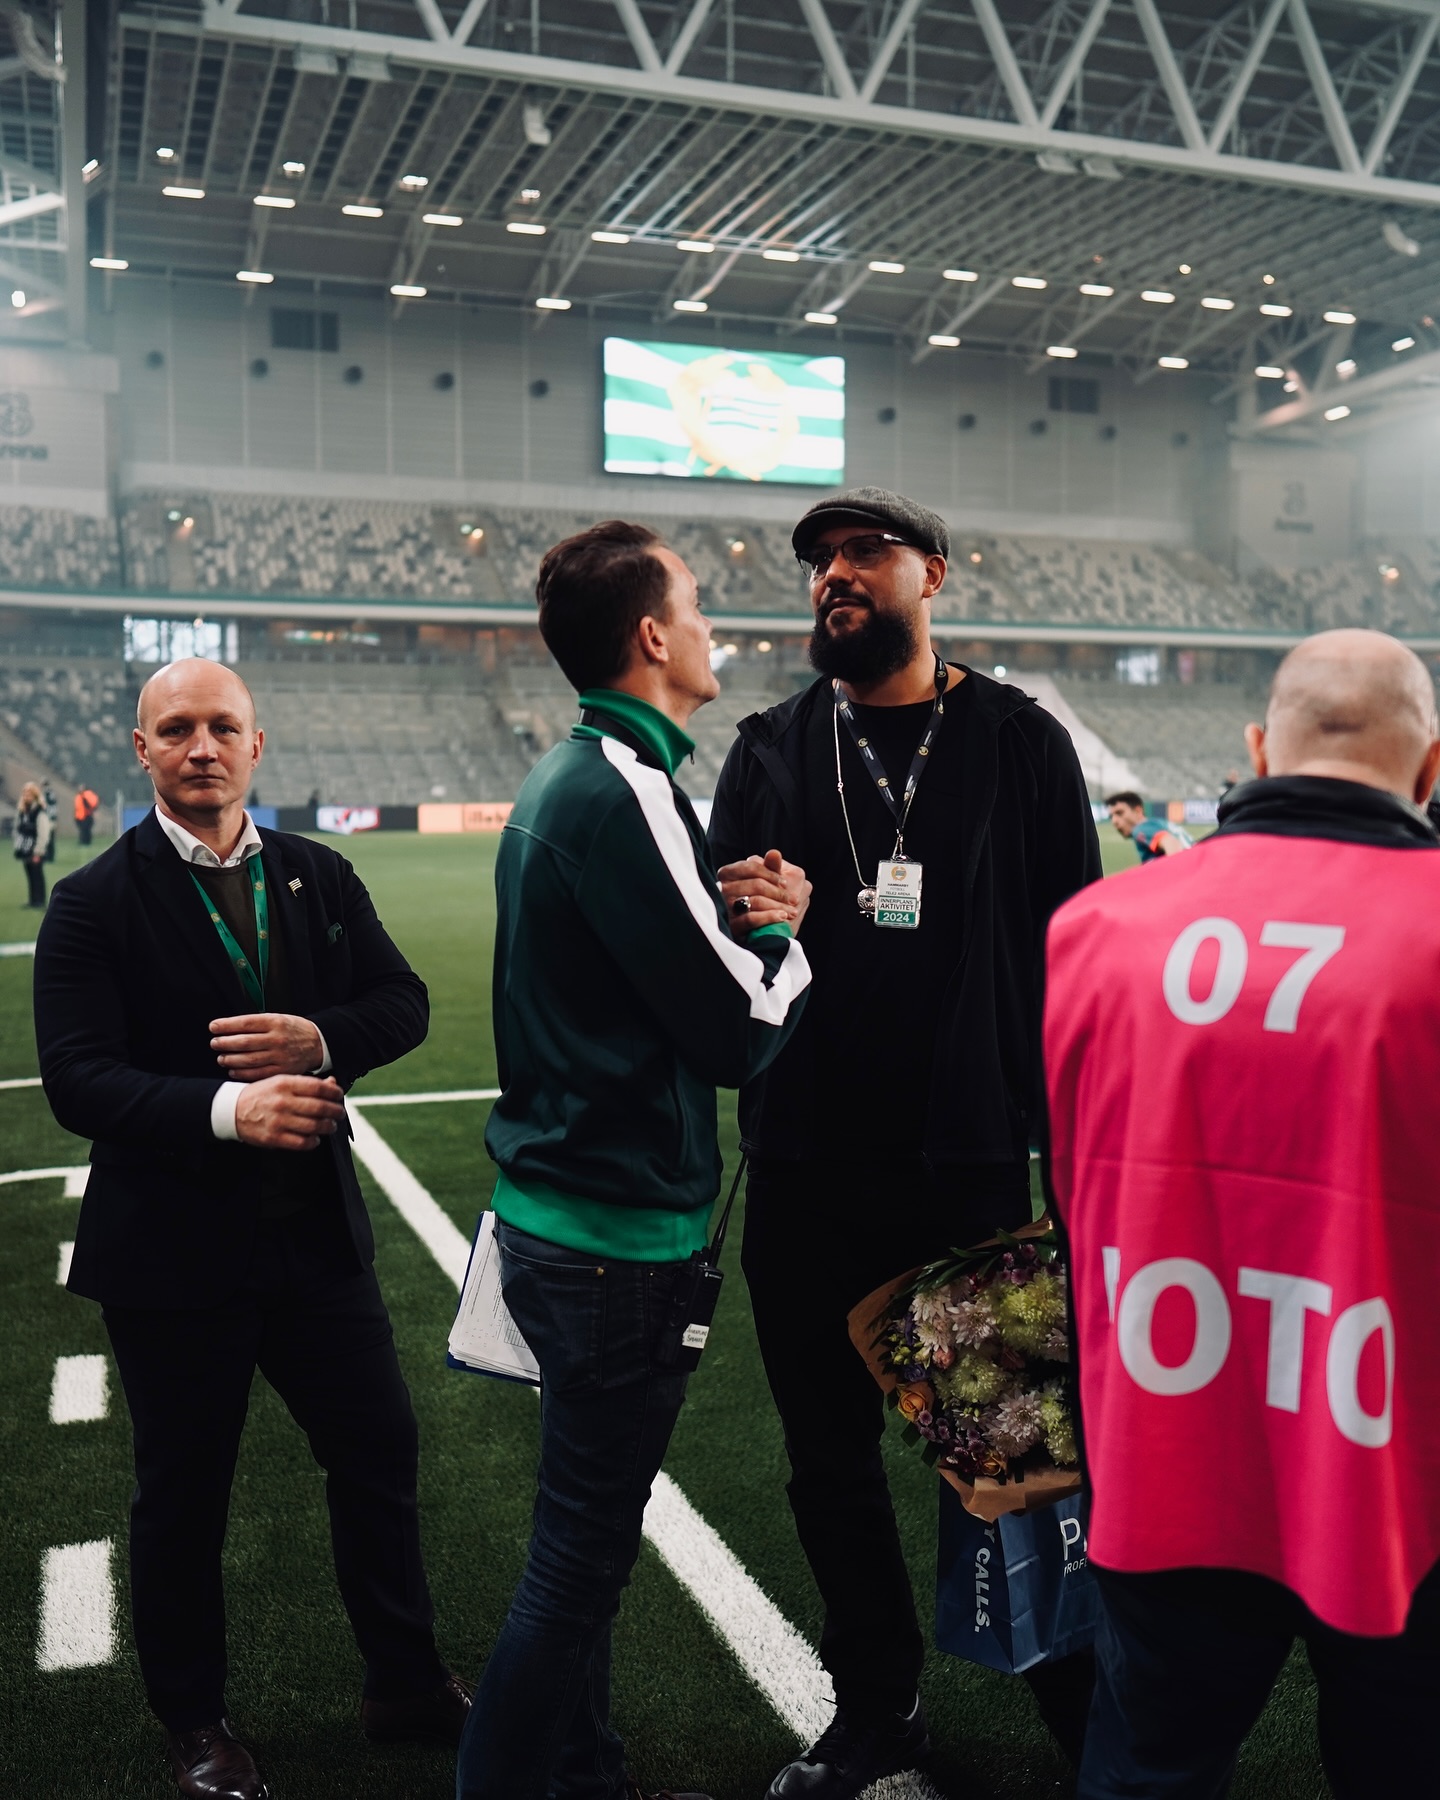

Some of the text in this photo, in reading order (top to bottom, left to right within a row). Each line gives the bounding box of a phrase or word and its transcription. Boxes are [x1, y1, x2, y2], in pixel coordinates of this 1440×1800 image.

[880, 903, 913, 911] AKTIVITET
[883, 912, 909, 922] 2024
[1161, 916, 1347, 1034] 07
[1060, 1517, 1088, 1561] P
[974, 1547, 991, 1633] CALLS.
